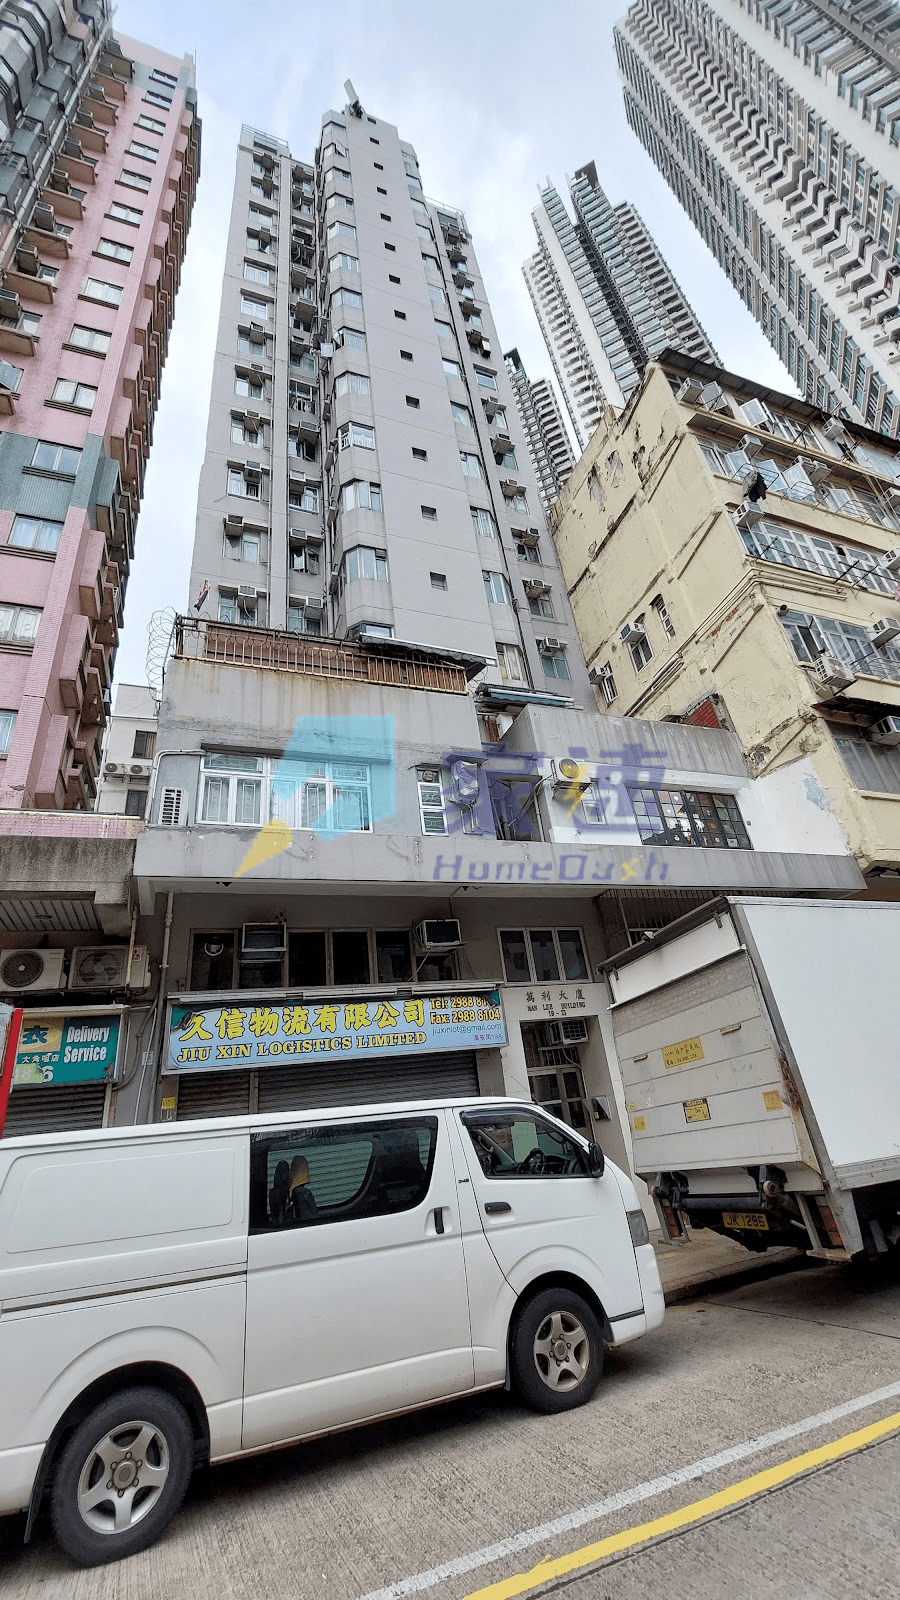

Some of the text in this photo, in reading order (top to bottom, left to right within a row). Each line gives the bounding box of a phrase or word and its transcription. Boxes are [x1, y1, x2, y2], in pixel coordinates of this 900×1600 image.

[429, 997, 448, 1009] Tel:
[450, 995, 475, 1009] 2988
[179, 998, 425, 1042] 久信物流有限公司
[429, 1007, 501, 1025] Fax: 2988 8104
[66, 1025, 111, 1044] Delivery
[63, 1044, 108, 1064] Service
[177, 1031, 427, 1062] JIU XIN LOGISTICS LIMITED
[726, 1213, 766, 1228] JK 1296
